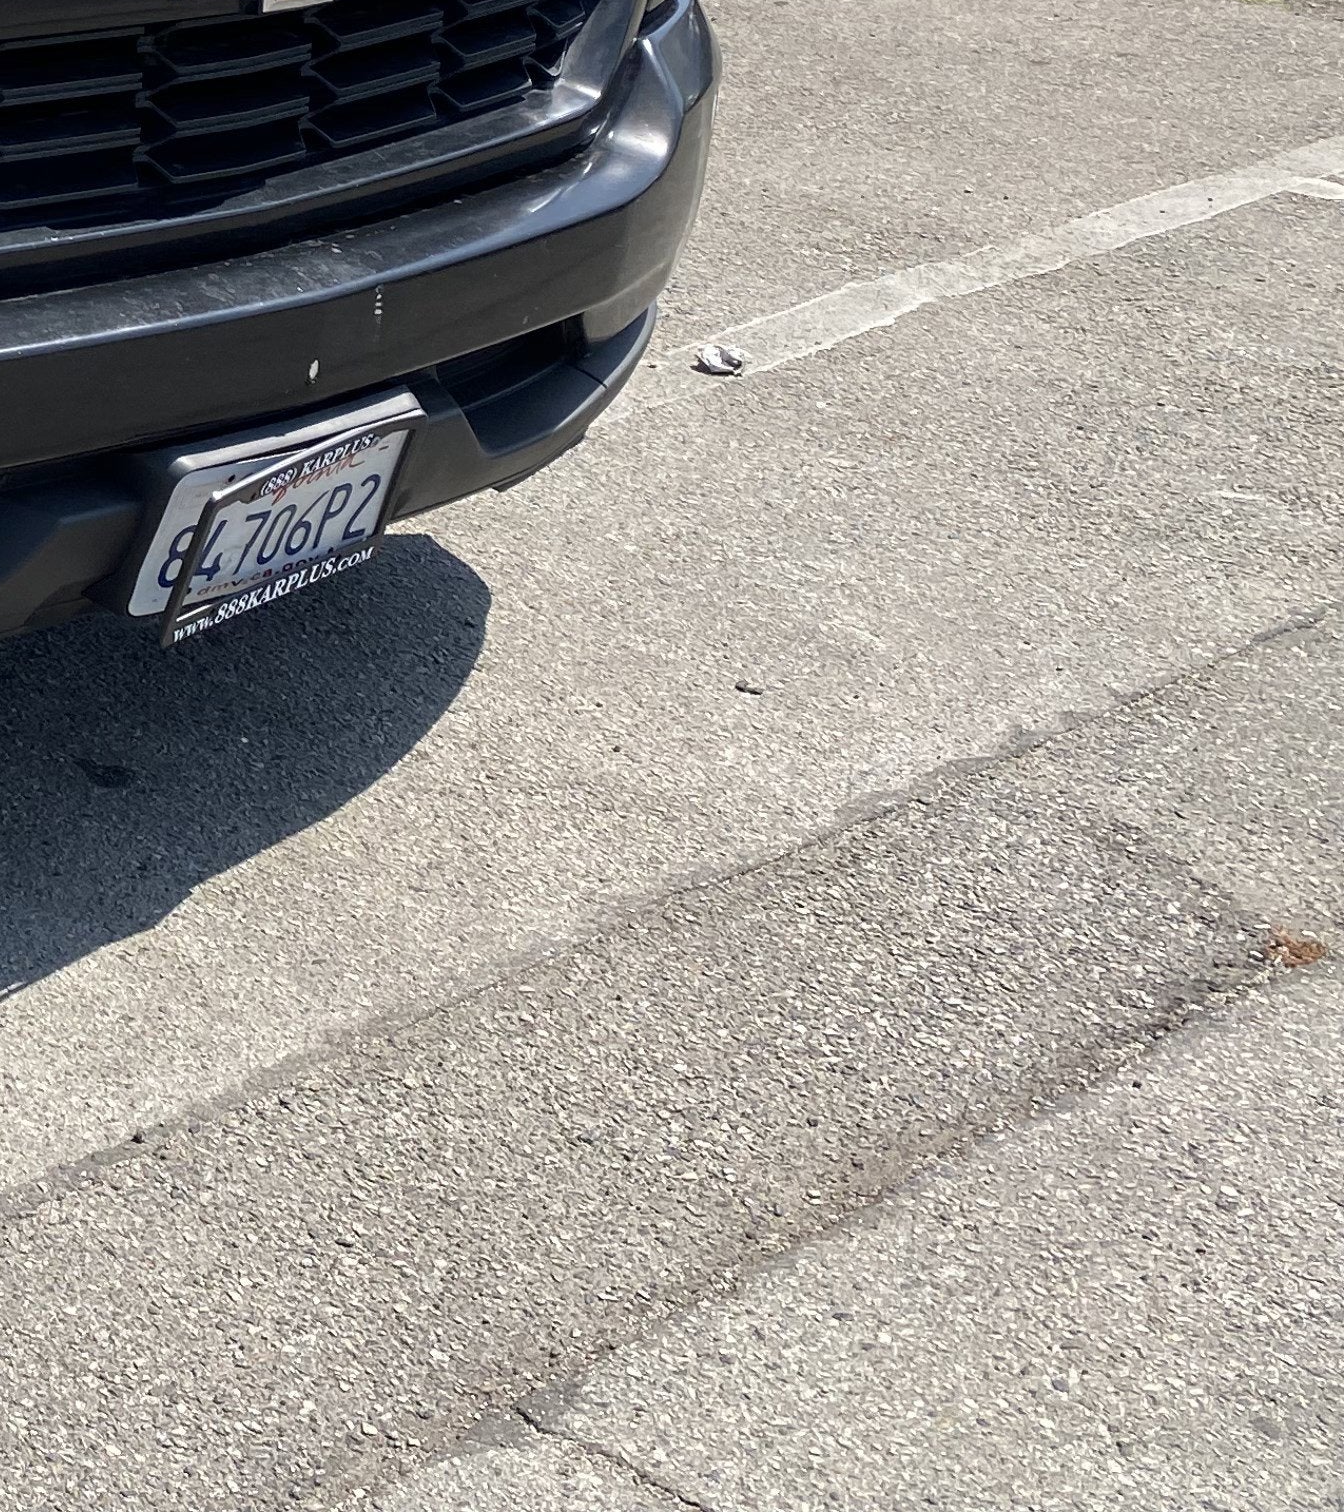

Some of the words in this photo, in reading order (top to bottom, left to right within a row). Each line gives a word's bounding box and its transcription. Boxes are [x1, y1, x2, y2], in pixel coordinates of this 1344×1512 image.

[261, 467, 298, 496] (888)
[301, 434, 375, 477] KARPLUS
[158, 474, 381, 589] 84706P2
